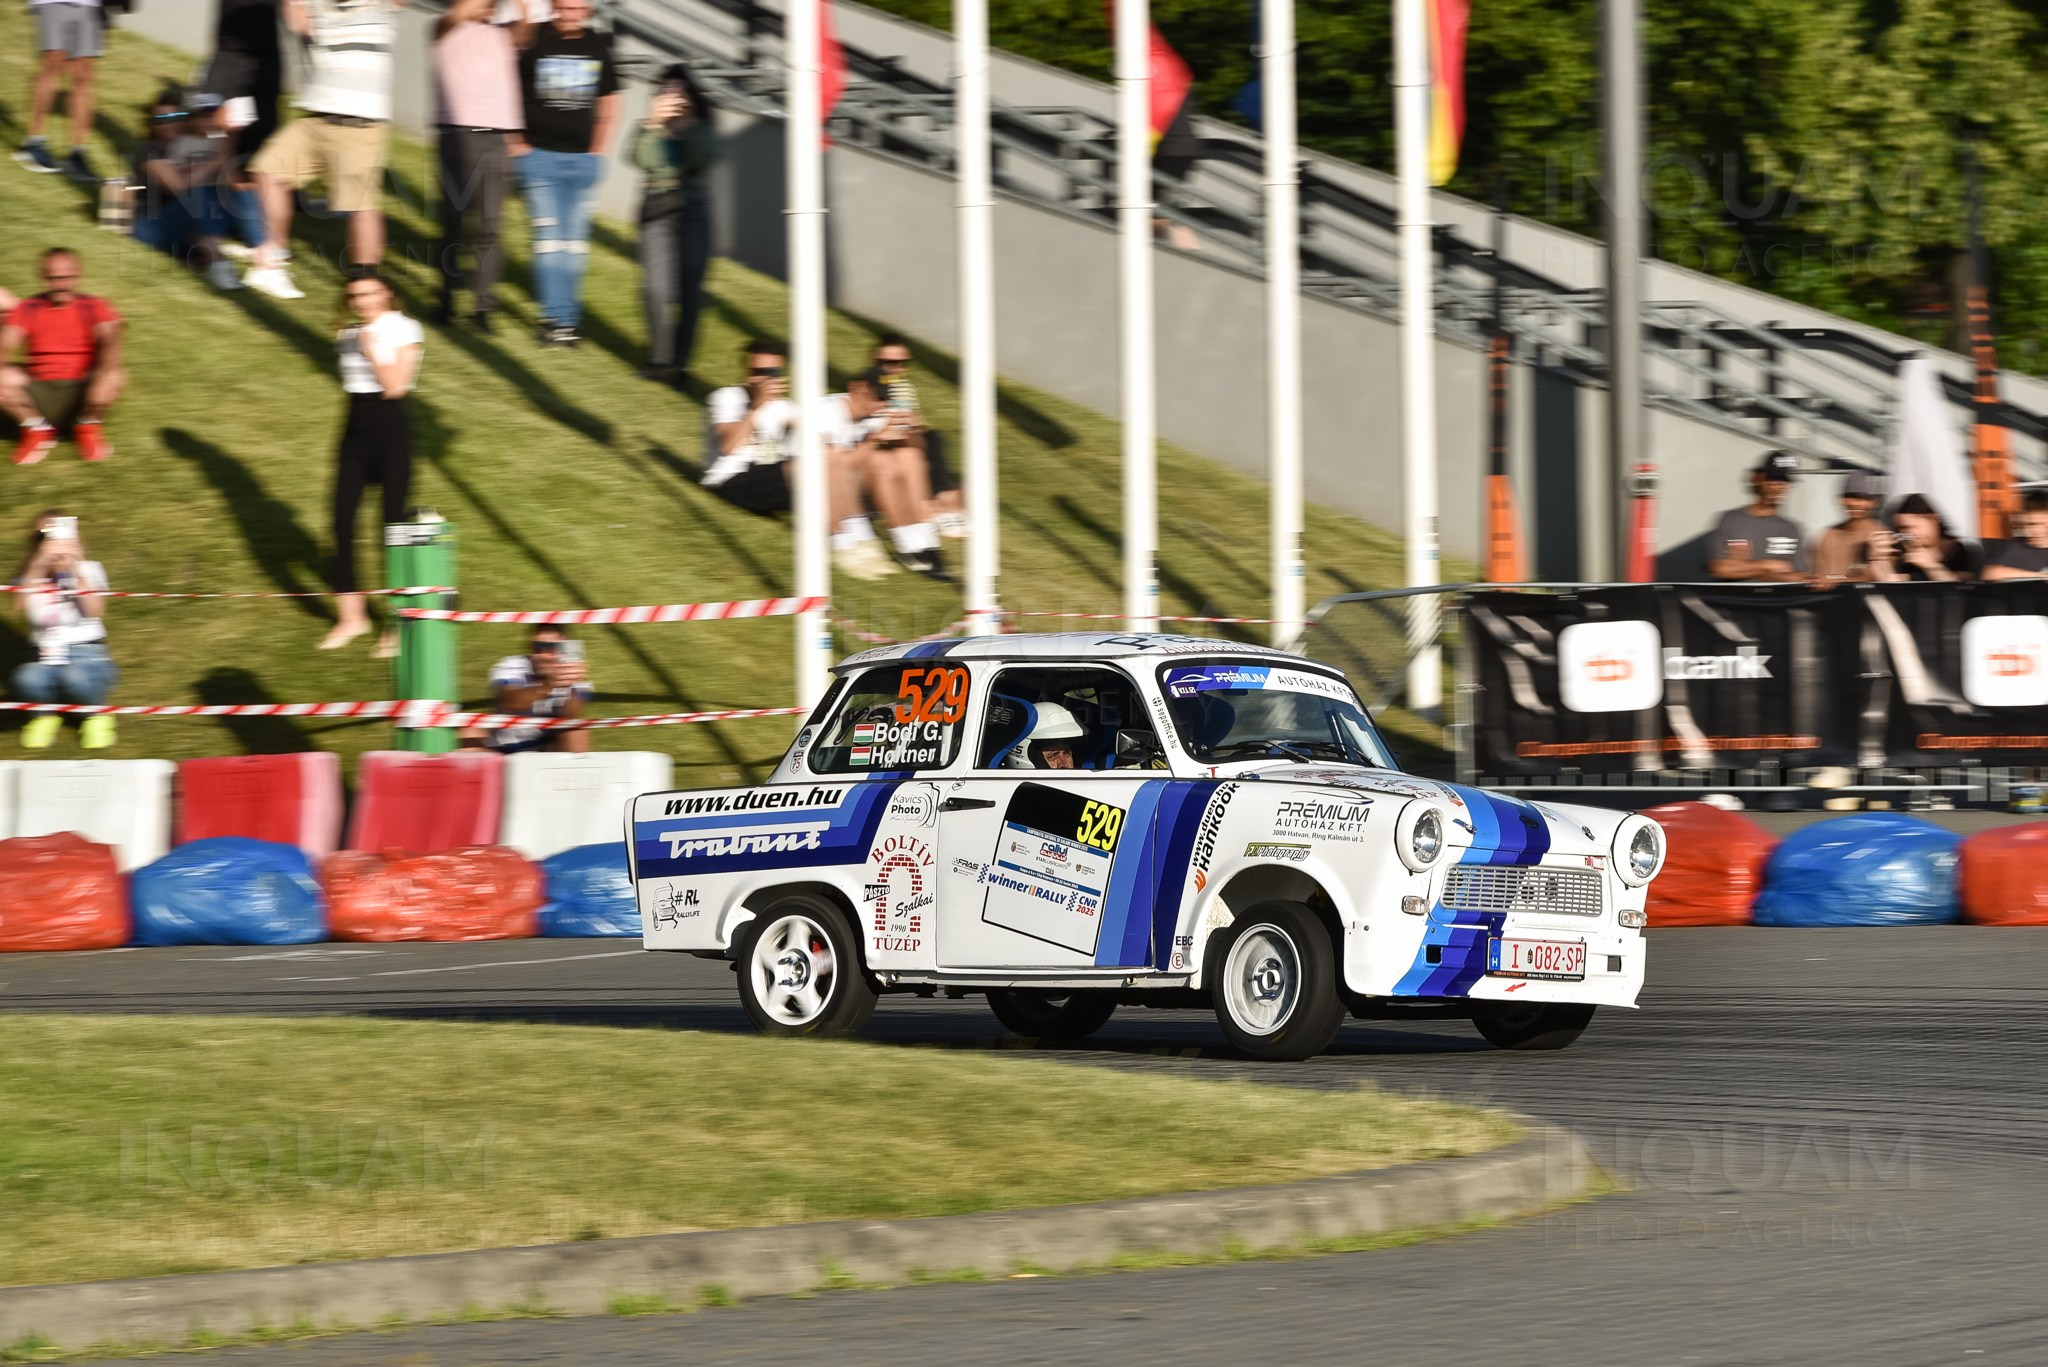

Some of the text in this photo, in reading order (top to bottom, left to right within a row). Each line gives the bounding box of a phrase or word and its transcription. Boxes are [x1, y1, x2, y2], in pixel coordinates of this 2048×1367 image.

[1213, 671, 1266, 684] PRÉMIUM
[1278, 675, 1330, 692] AUTÓHÁZ
[896, 667, 969, 724] 529
[874, 720, 943, 742] Bódi G.
[1157, 707, 1178, 749] sepoffice.hu
[664, 786, 842, 815] www.duen.hu
[891, 805, 921, 814] Photo
[893, 794, 922, 804] Kavics
[1276, 799, 1370, 823] PRÉMIUM
[1077, 800, 1122, 852] 529
[1192, 783, 1229, 867] www.duen.hu
[1275, 817, 1365, 833] AUTÓHÁZ KFT.
[658, 821, 831, 860] Trabant
[1287, 831, 1310, 839] Hatvan,
[1312, 832, 1327, 841] Ring
[871, 834, 935, 868] BOLTÍV
[957, 858, 980, 871] FRAS
[988, 873, 1067, 905] winner RALLY
[895, 893, 934, 919] Szalkai
[1076, 904, 1095, 917] 2025
[1078, 896, 1098, 909] CNR
[890, 923, 907, 932] 1990
[873, 934, 922, 952] TÜZÉP
[1175, 936, 1193, 946] EBC
[1491, 957, 1498, 967] H
